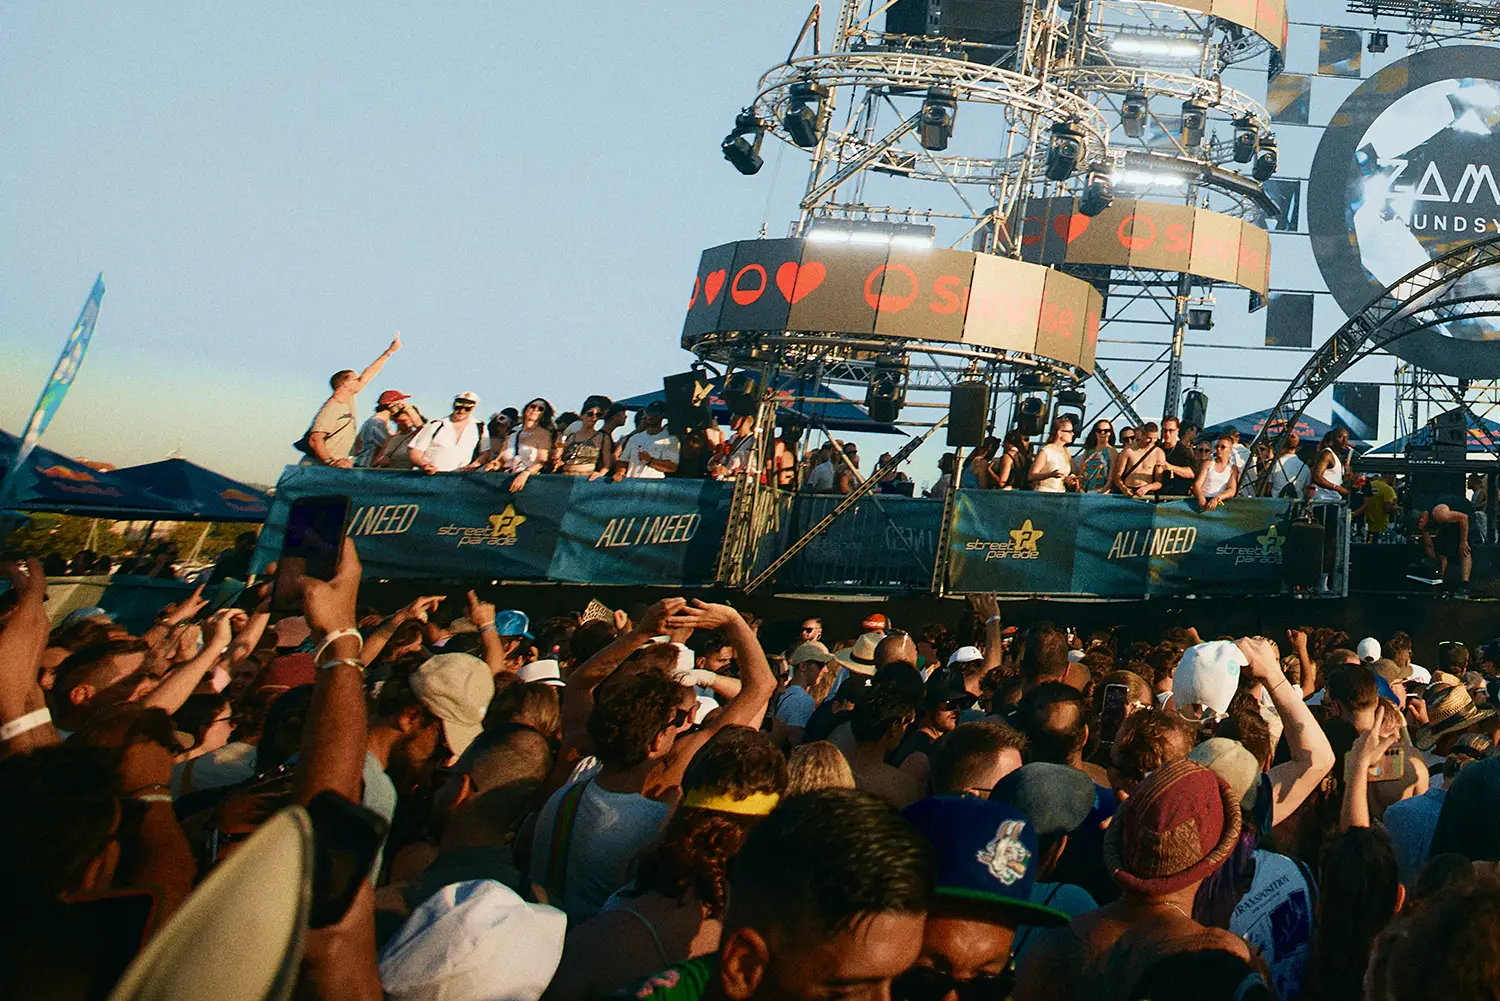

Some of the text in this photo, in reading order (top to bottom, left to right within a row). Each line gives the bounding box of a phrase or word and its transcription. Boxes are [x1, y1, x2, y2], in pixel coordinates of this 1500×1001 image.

[356, 504, 419, 536] NEED
[437, 523, 493, 536] street
[594, 513, 702, 548] ALL I NEED
[457, 534, 518, 548] parade
[965, 537, 1015, 551] street
[1107, 526, 1198, 559] ALL I NEED
[985, 549, 1040, 561] parade
[1216, 544, 1264, 556] street
